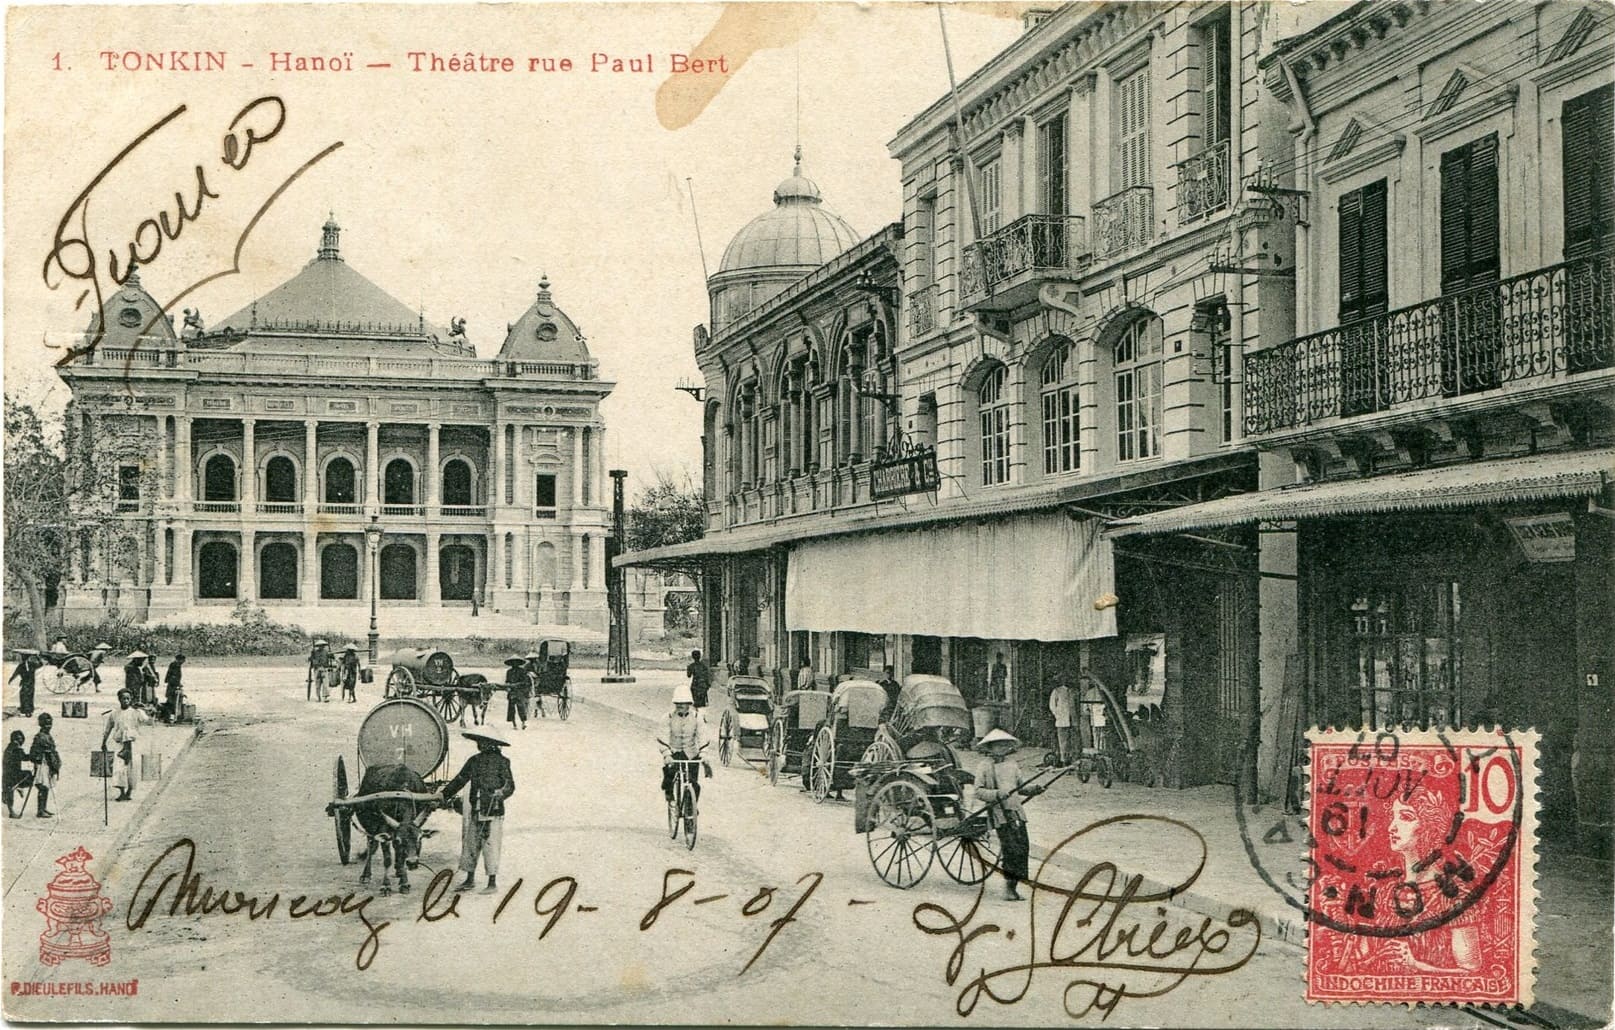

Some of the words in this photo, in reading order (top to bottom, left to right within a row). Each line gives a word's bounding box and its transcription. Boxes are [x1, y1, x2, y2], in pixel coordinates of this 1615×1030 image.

[389, 723, 413, 738] VH
[1463, 756, 1516, 815] 10
[1320, 976, 1417, 991] INDOCHINE
[1421, 976, 1511, 993] FRANÇAISE
